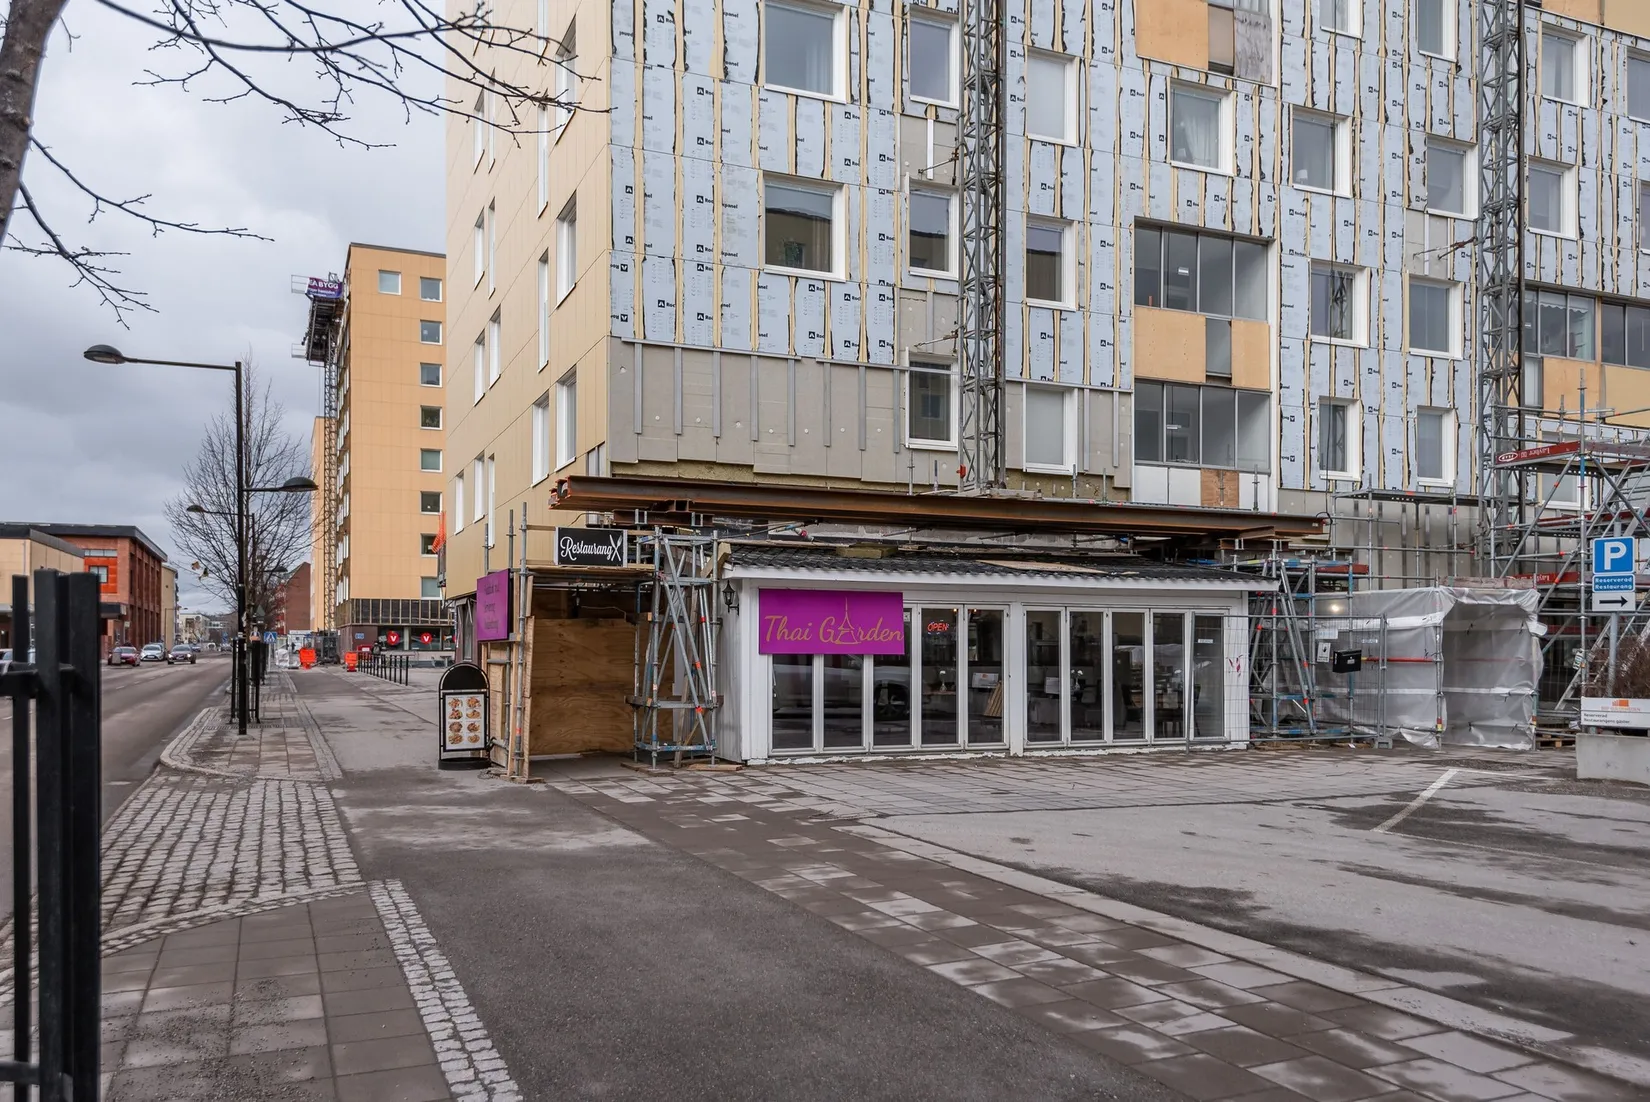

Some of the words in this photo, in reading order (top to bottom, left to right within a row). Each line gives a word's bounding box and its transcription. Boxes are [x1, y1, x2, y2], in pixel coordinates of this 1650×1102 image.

[1529, 447, 1550, 456] Layher
[560, 536, 613, 561] Restaurang
[1604, 542, 1627, 570] P
[764, 615, 813, 642] Thai
[819, 598, 904, 645] Garden
[927, 622, 948, 632] OPEN
